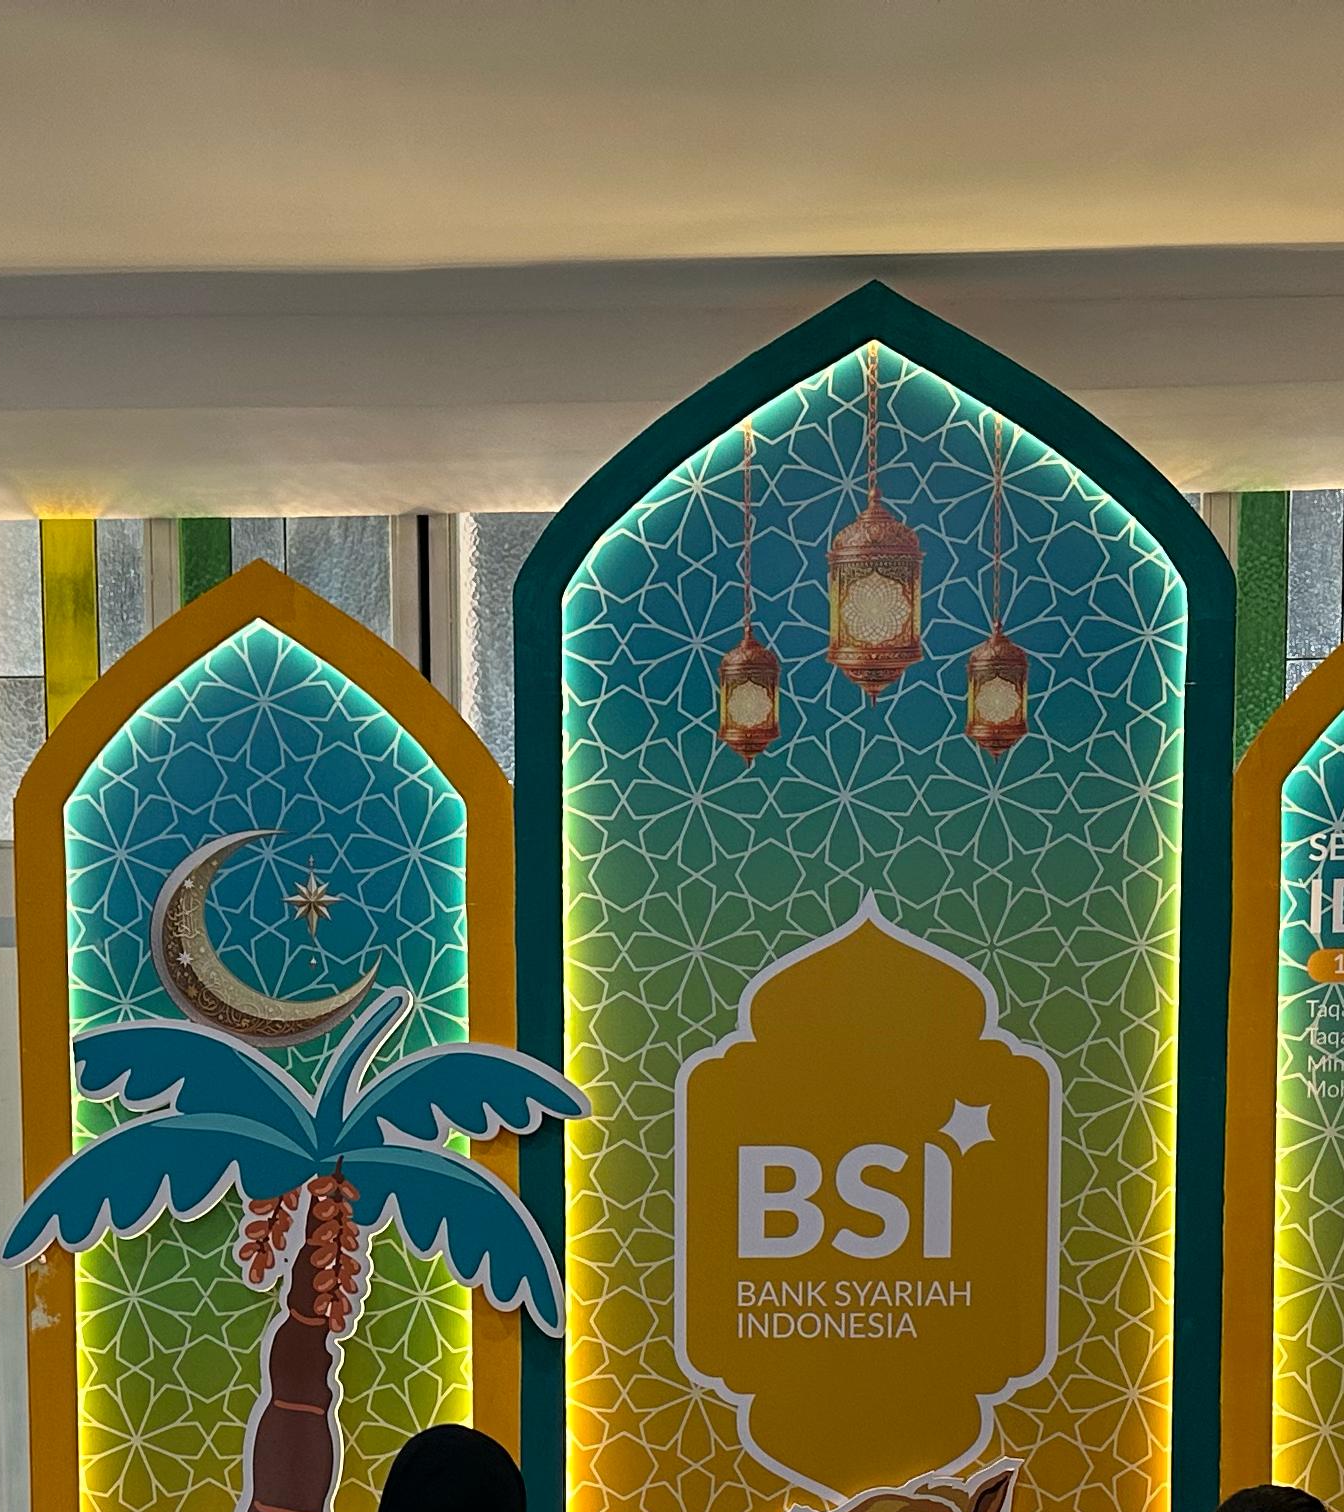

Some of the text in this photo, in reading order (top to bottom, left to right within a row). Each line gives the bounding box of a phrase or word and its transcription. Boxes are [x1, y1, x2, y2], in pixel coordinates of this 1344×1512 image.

[737, 1142, 952, 1259] BSI
[737, 1281, 972, 1307] BANK SYARIAH
[737, 1313, 918, 1339] INDONESIA
